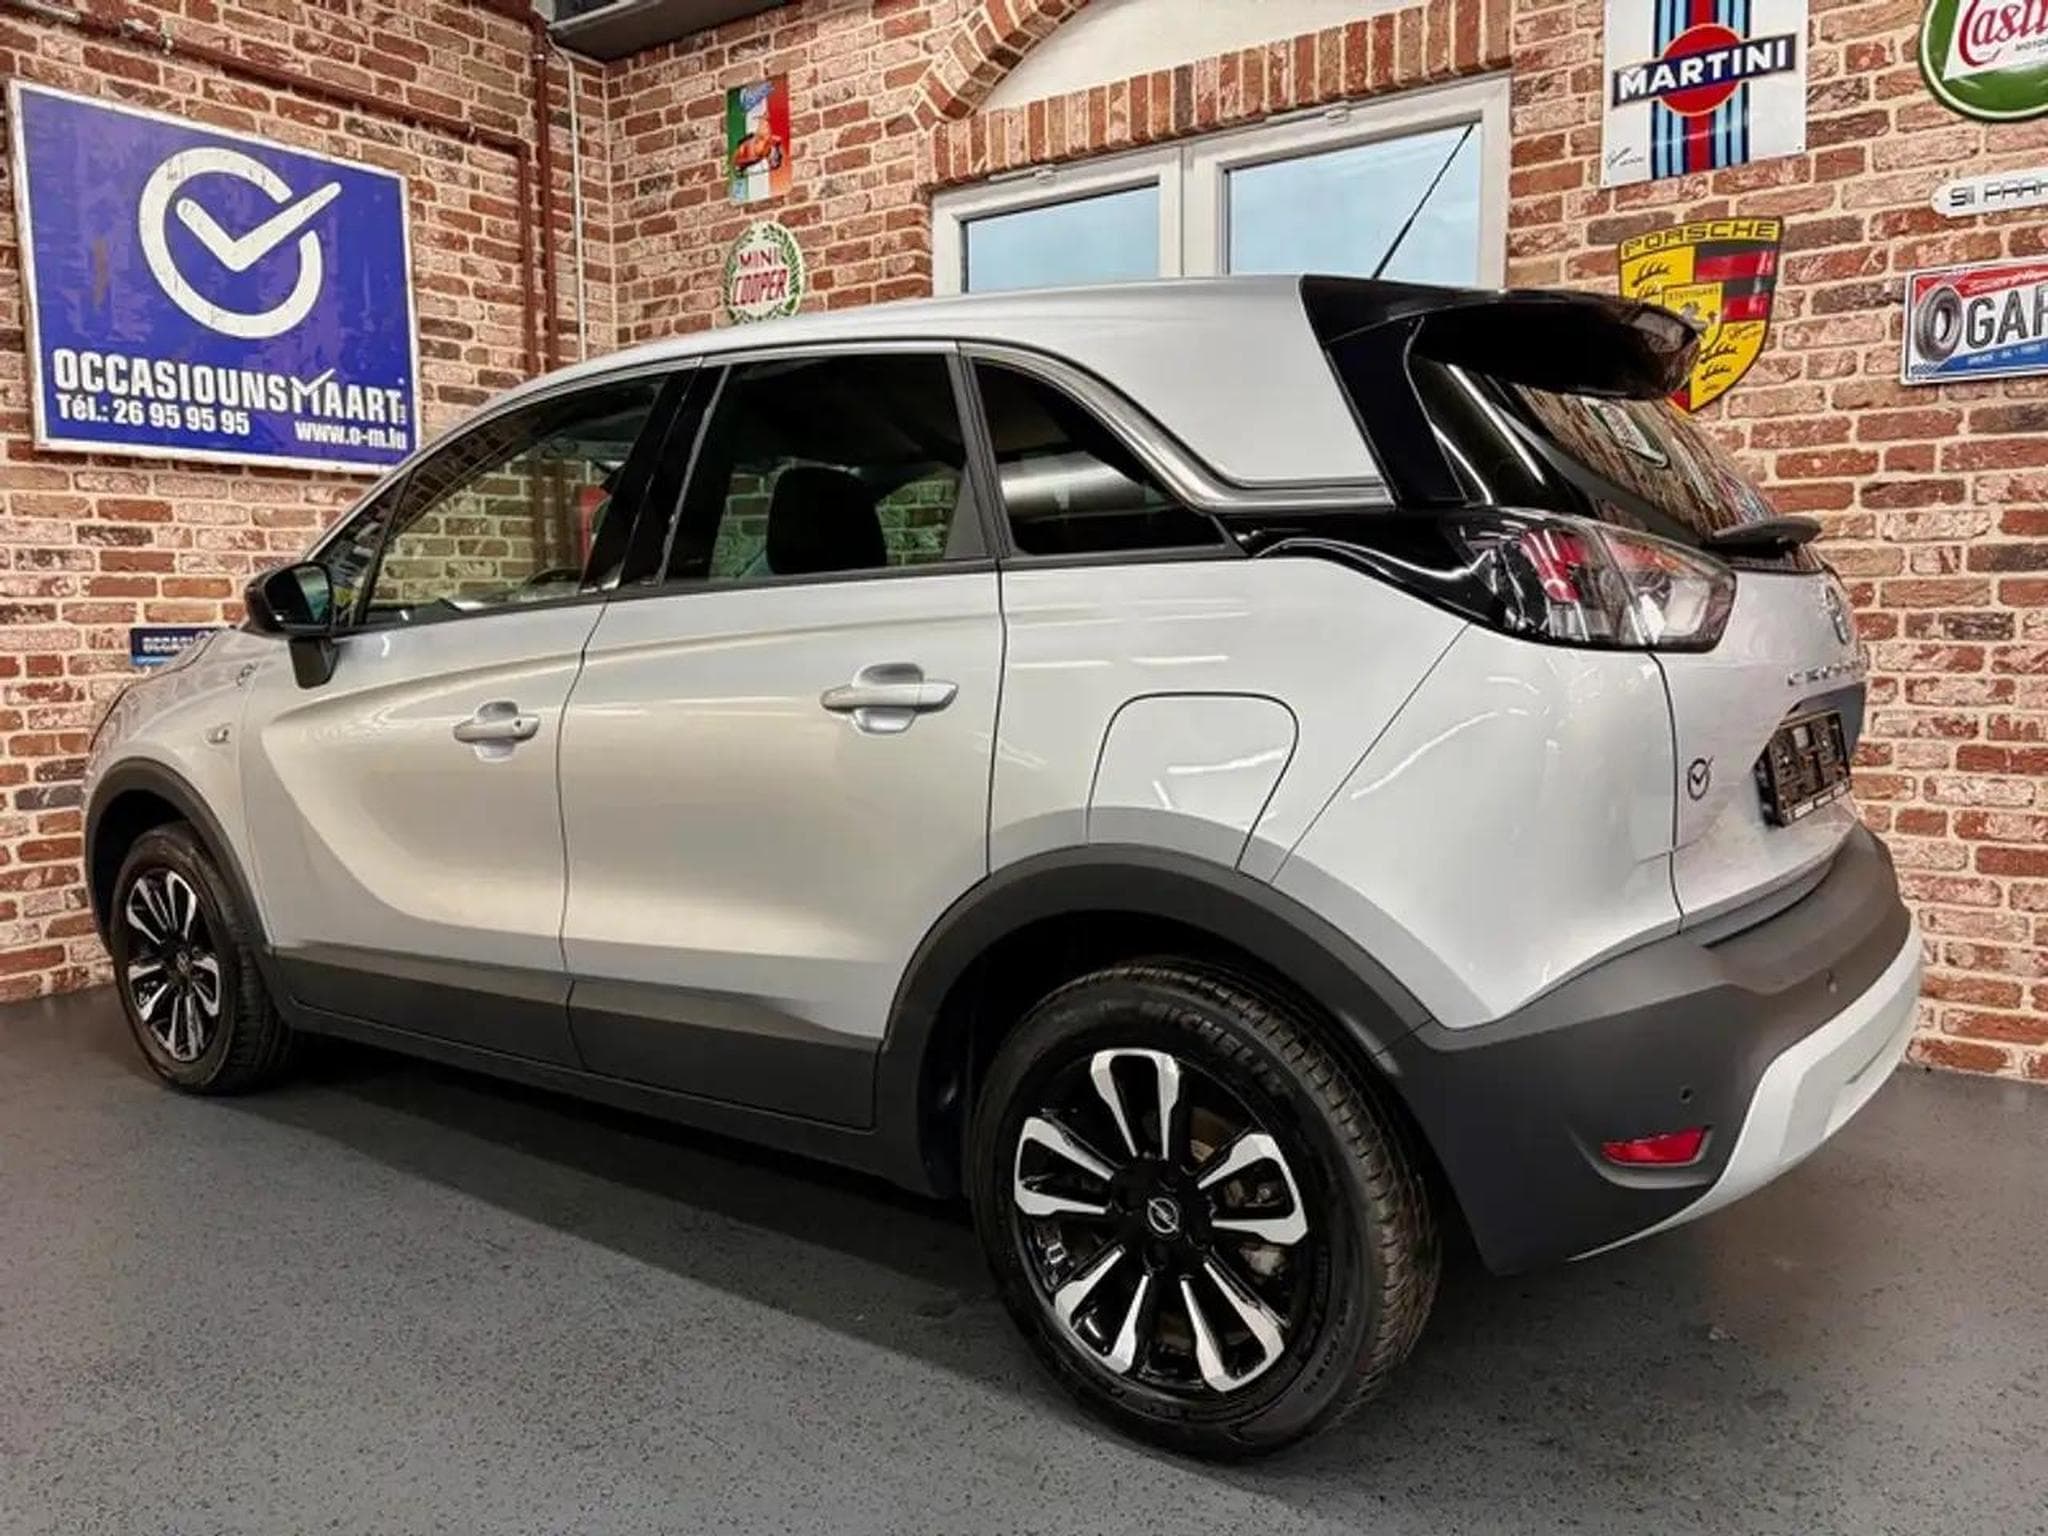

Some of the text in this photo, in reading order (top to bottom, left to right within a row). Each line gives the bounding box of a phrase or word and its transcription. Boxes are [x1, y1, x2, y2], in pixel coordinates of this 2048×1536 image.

[1619, 40, 1787, 99] MARTINI
[739, 246, 778, 267] MINI
[1622, 222, 1775, 257] PORSCHE
[733, 268, 788, 306] COOPER
[53, 348, 403, 424] OCCASIOUNSMAART
[56, 393, 251, 436] Tél.: 26 95 95 95
[294, 421, 408, 450] www.o-m.lu
